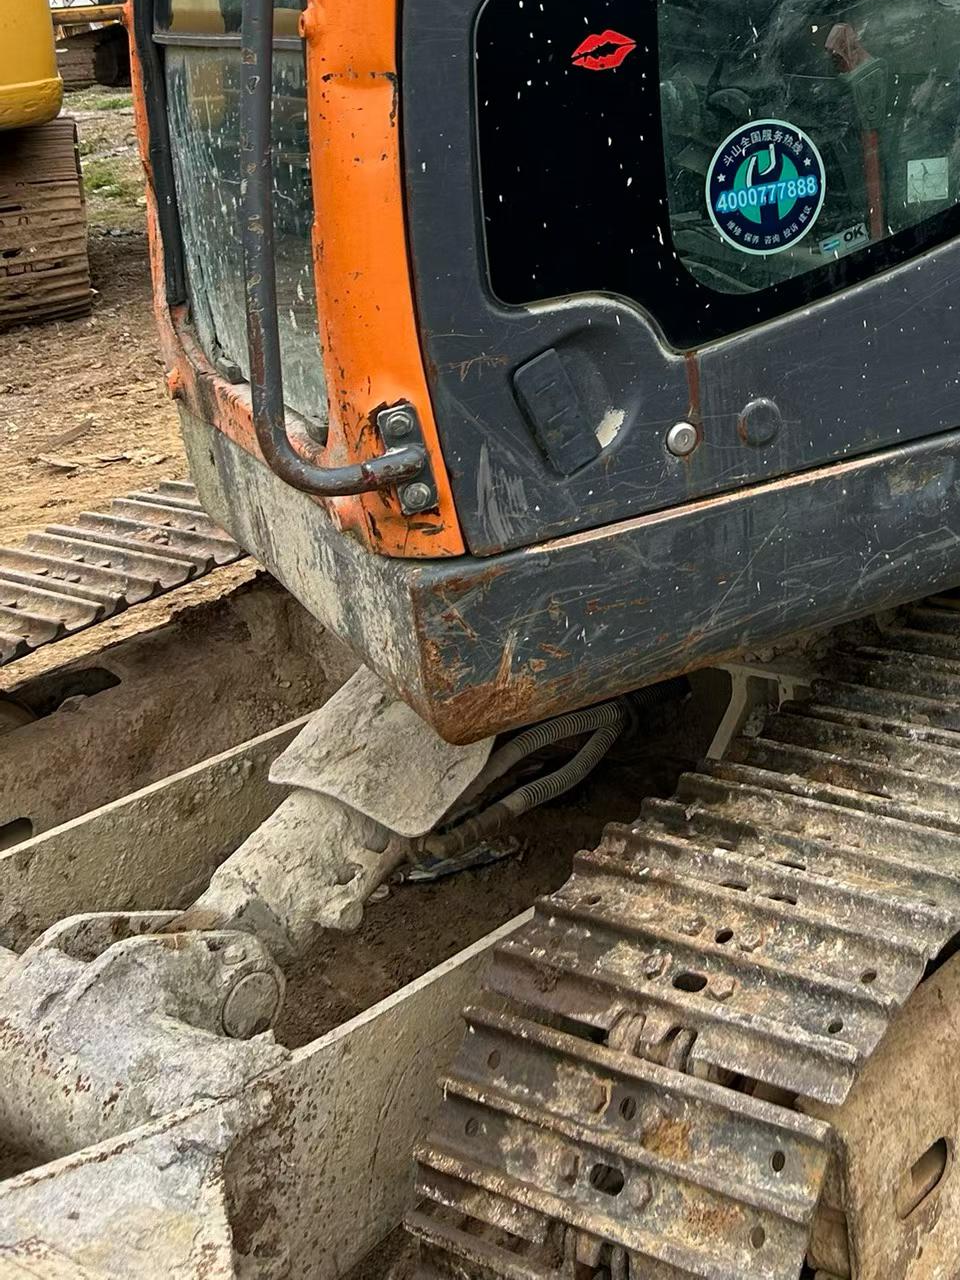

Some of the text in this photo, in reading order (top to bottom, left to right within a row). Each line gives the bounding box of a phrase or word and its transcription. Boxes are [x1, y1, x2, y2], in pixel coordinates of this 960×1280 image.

[723, 129, 805, 167] 斗山全国服务热线
[716, 176, 818, 212] 4000777888
[843, 223, 865, 242] OK
